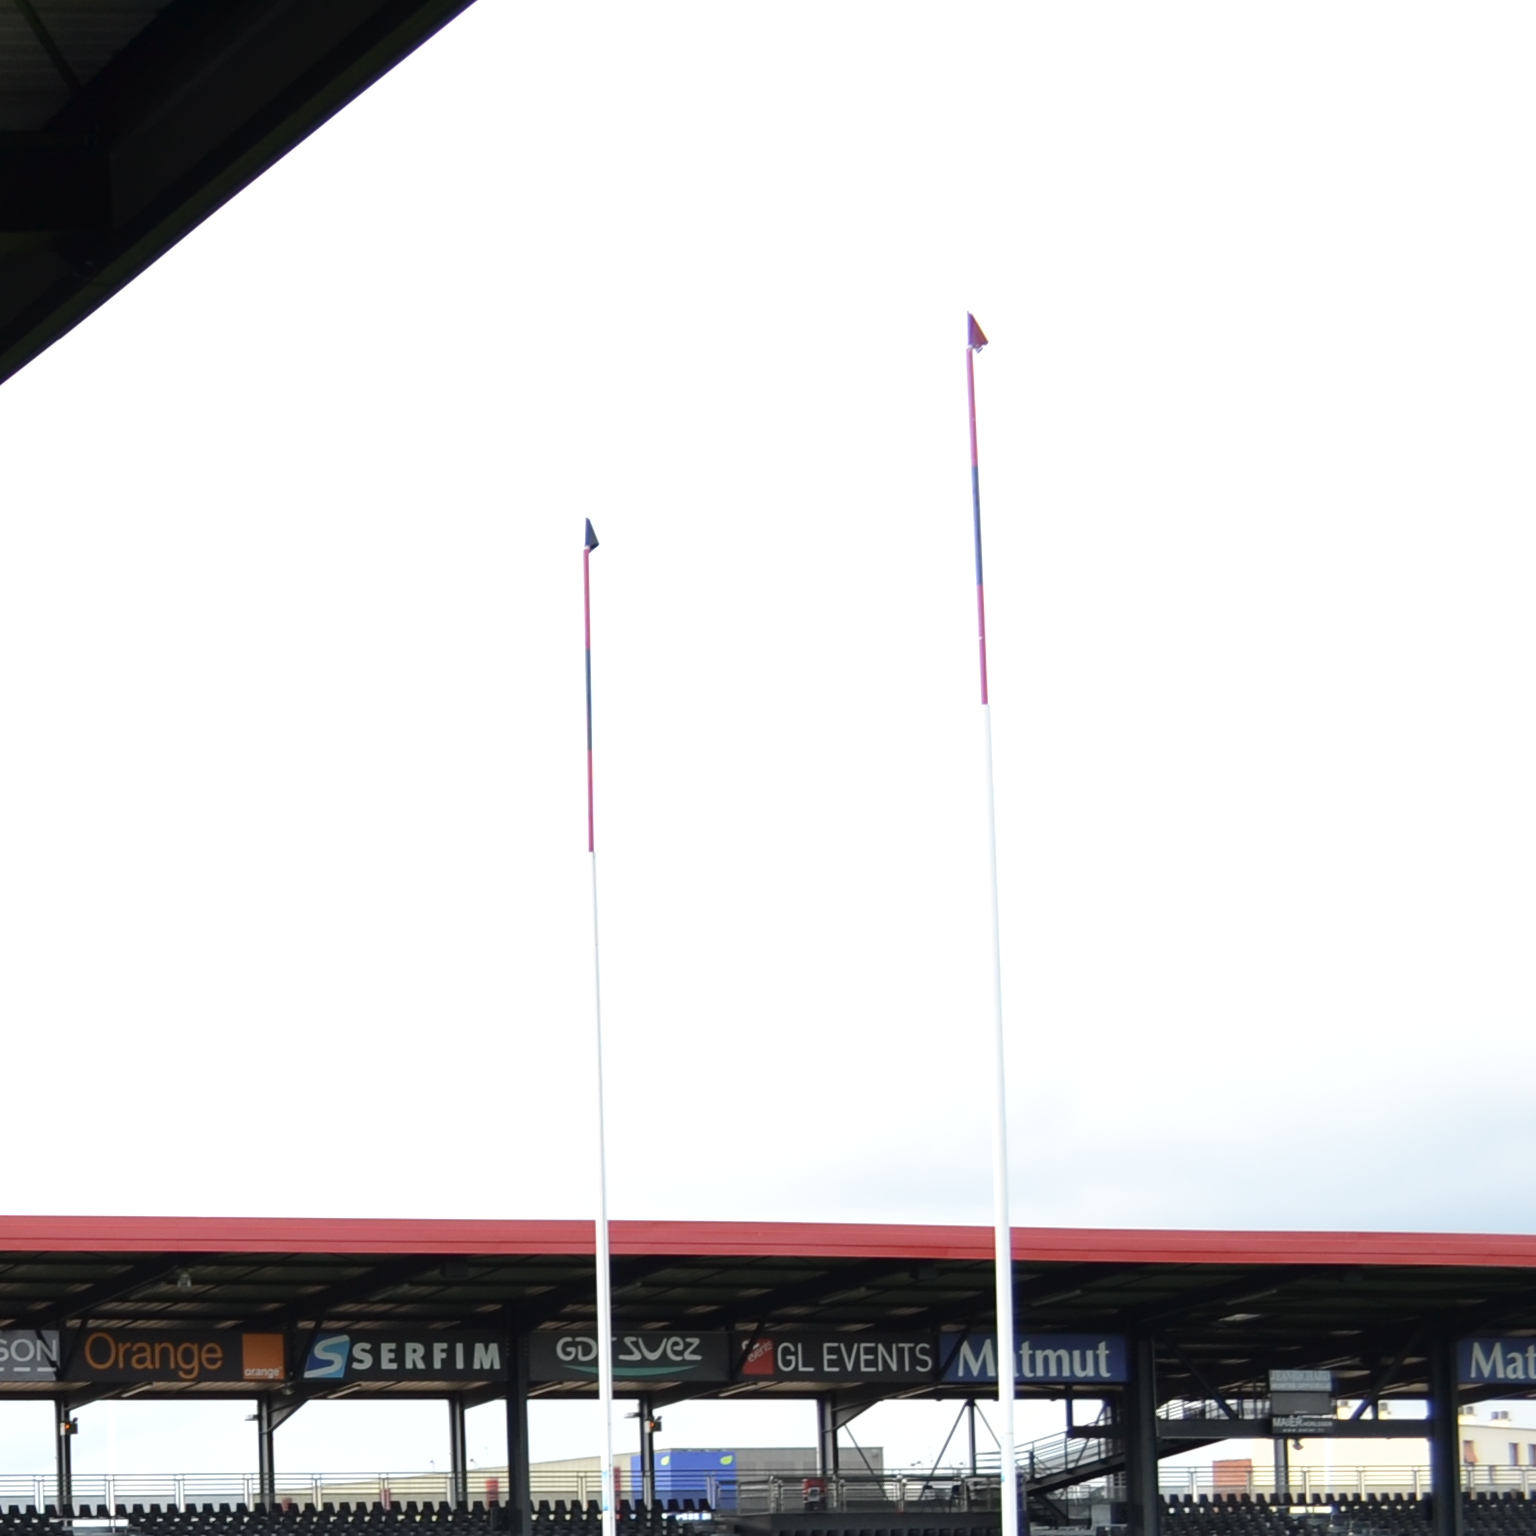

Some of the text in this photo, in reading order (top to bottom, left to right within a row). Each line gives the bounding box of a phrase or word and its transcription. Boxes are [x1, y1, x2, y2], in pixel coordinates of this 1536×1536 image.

[84, 1331, 223, 1380] Orange
[351, 1341, 502, 1370] SERFIM
[556, 1336, 617, 1362] GD
[777, 1342, 933, 1373] GL EVENTS
[957, 1338, 1112, 1378] Mtmut
[244, 1367, 281, 1379] orange
